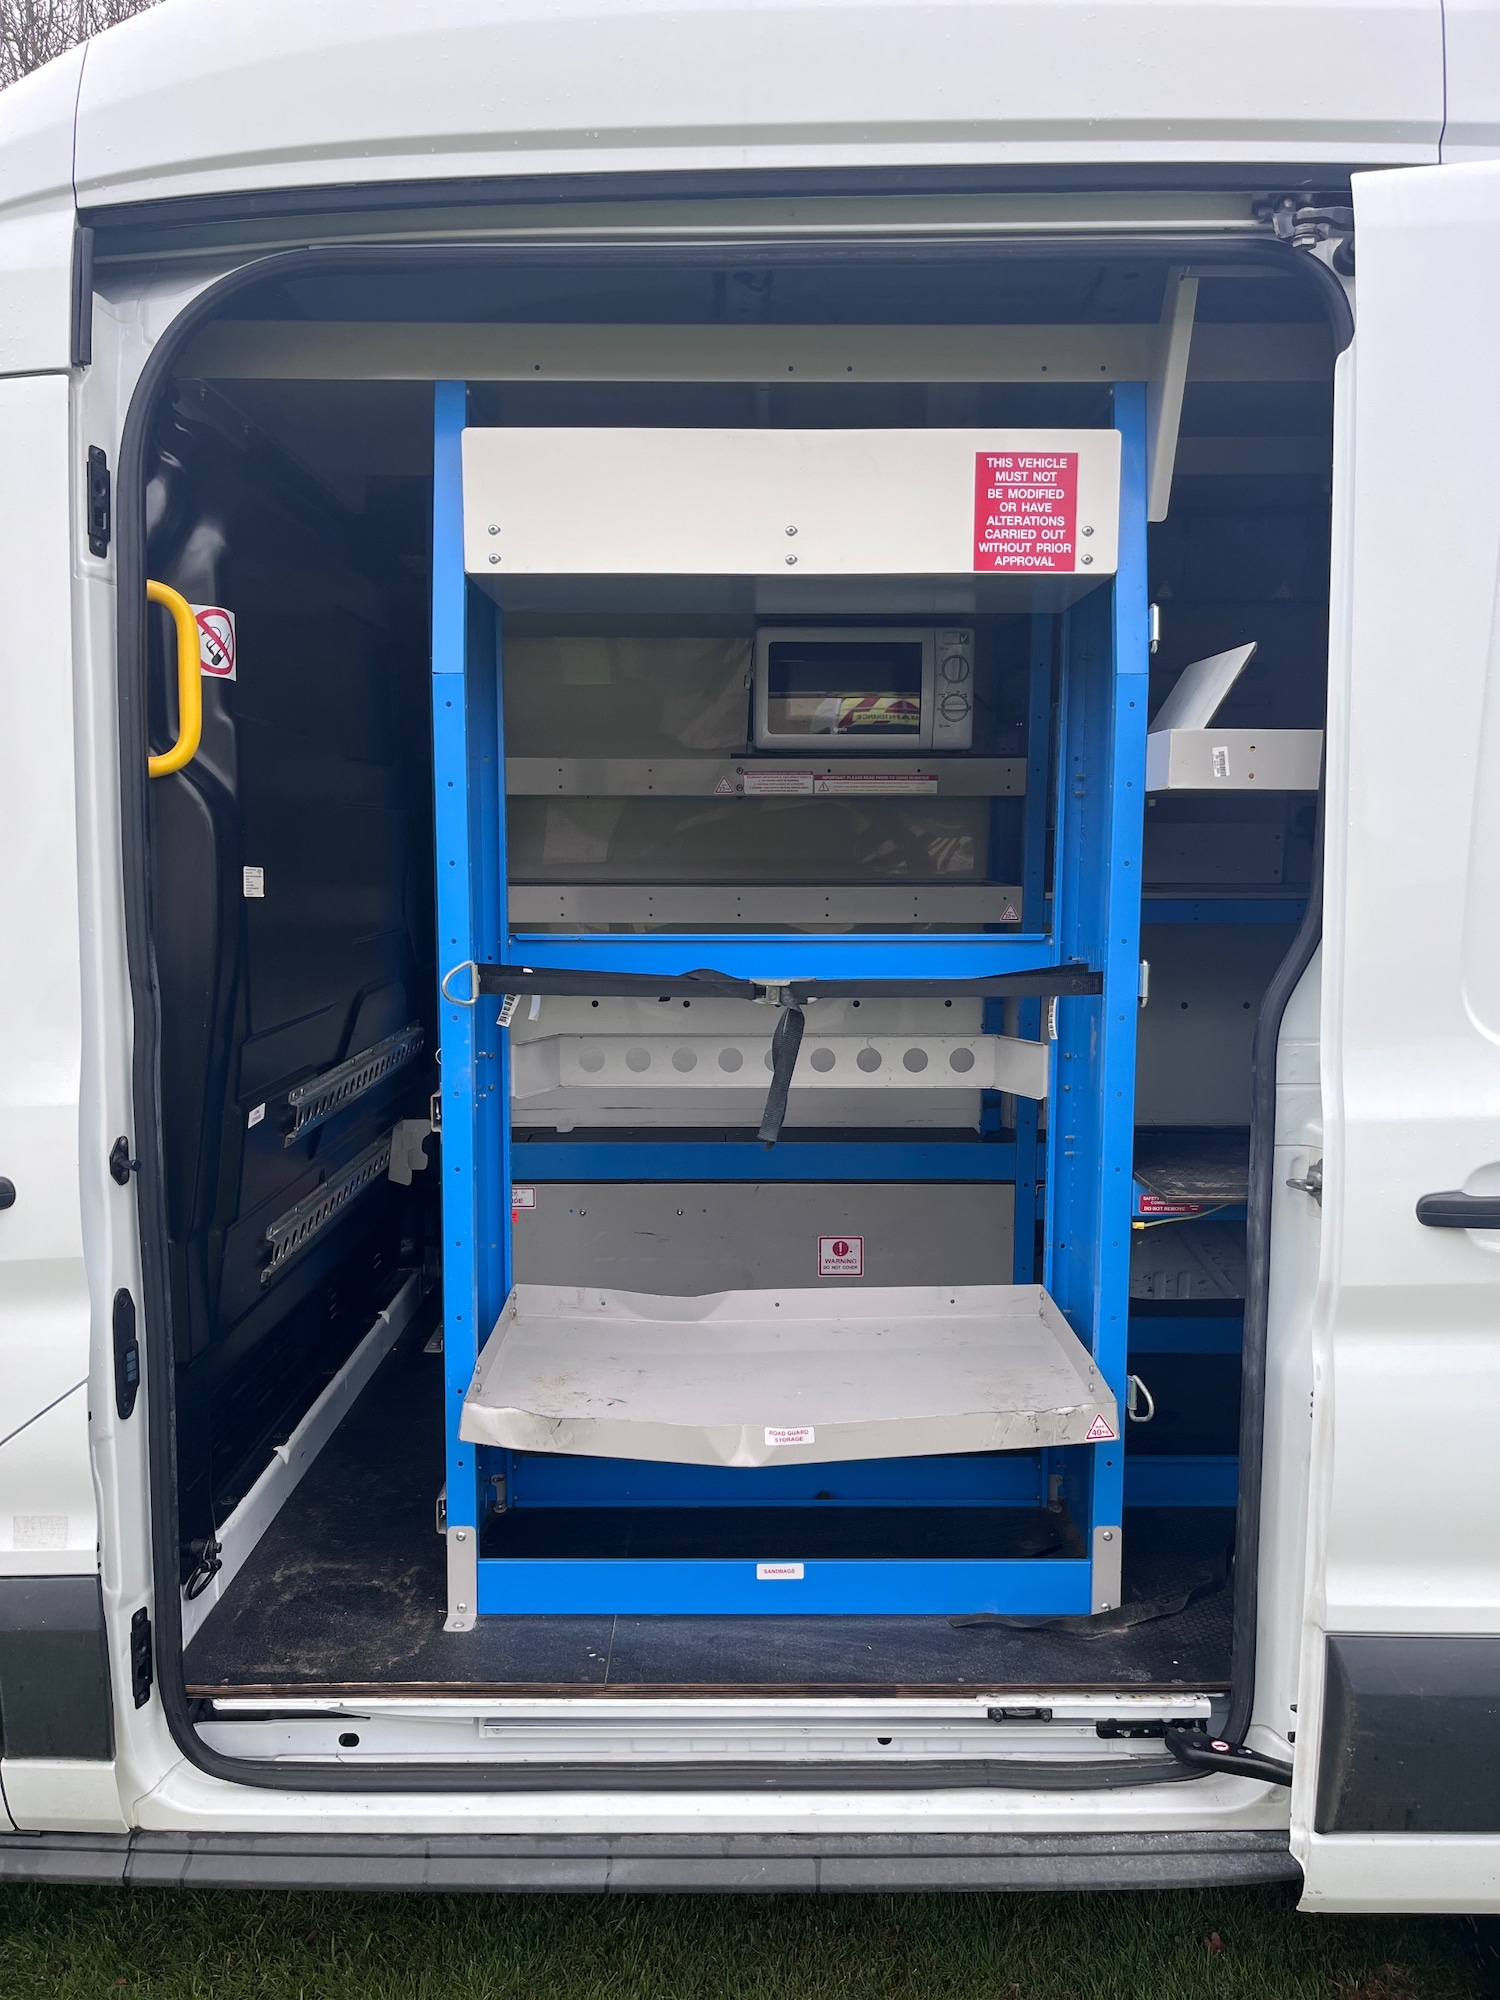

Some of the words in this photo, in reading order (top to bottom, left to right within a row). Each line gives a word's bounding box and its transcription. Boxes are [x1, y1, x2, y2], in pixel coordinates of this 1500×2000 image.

[987, 458, 1013, 468] THIS
[1018, 458, 1067, 468] VEHICLE
[995, 471, 1028, 482] MUST
[1033, 472, 1057, 482] NOT
[987, 488, 1003, 499] BE
[1008, 489, 1065, 499] MODIFIED
[1000, 502, 1016, 513] OR
[1021, 503, 1052, 513] HAVE
[986, 516, 1065, 526] ALTERATIONS
[985, 529, 1036, 539] CARRIED
[1041, 529, 1066, 540] OUT
[978, 542, 1032, 553] WITHOUT
[1036, 543, 1071, 553] PRIOR
[994, 556, 1055, 567] APPROVAL
